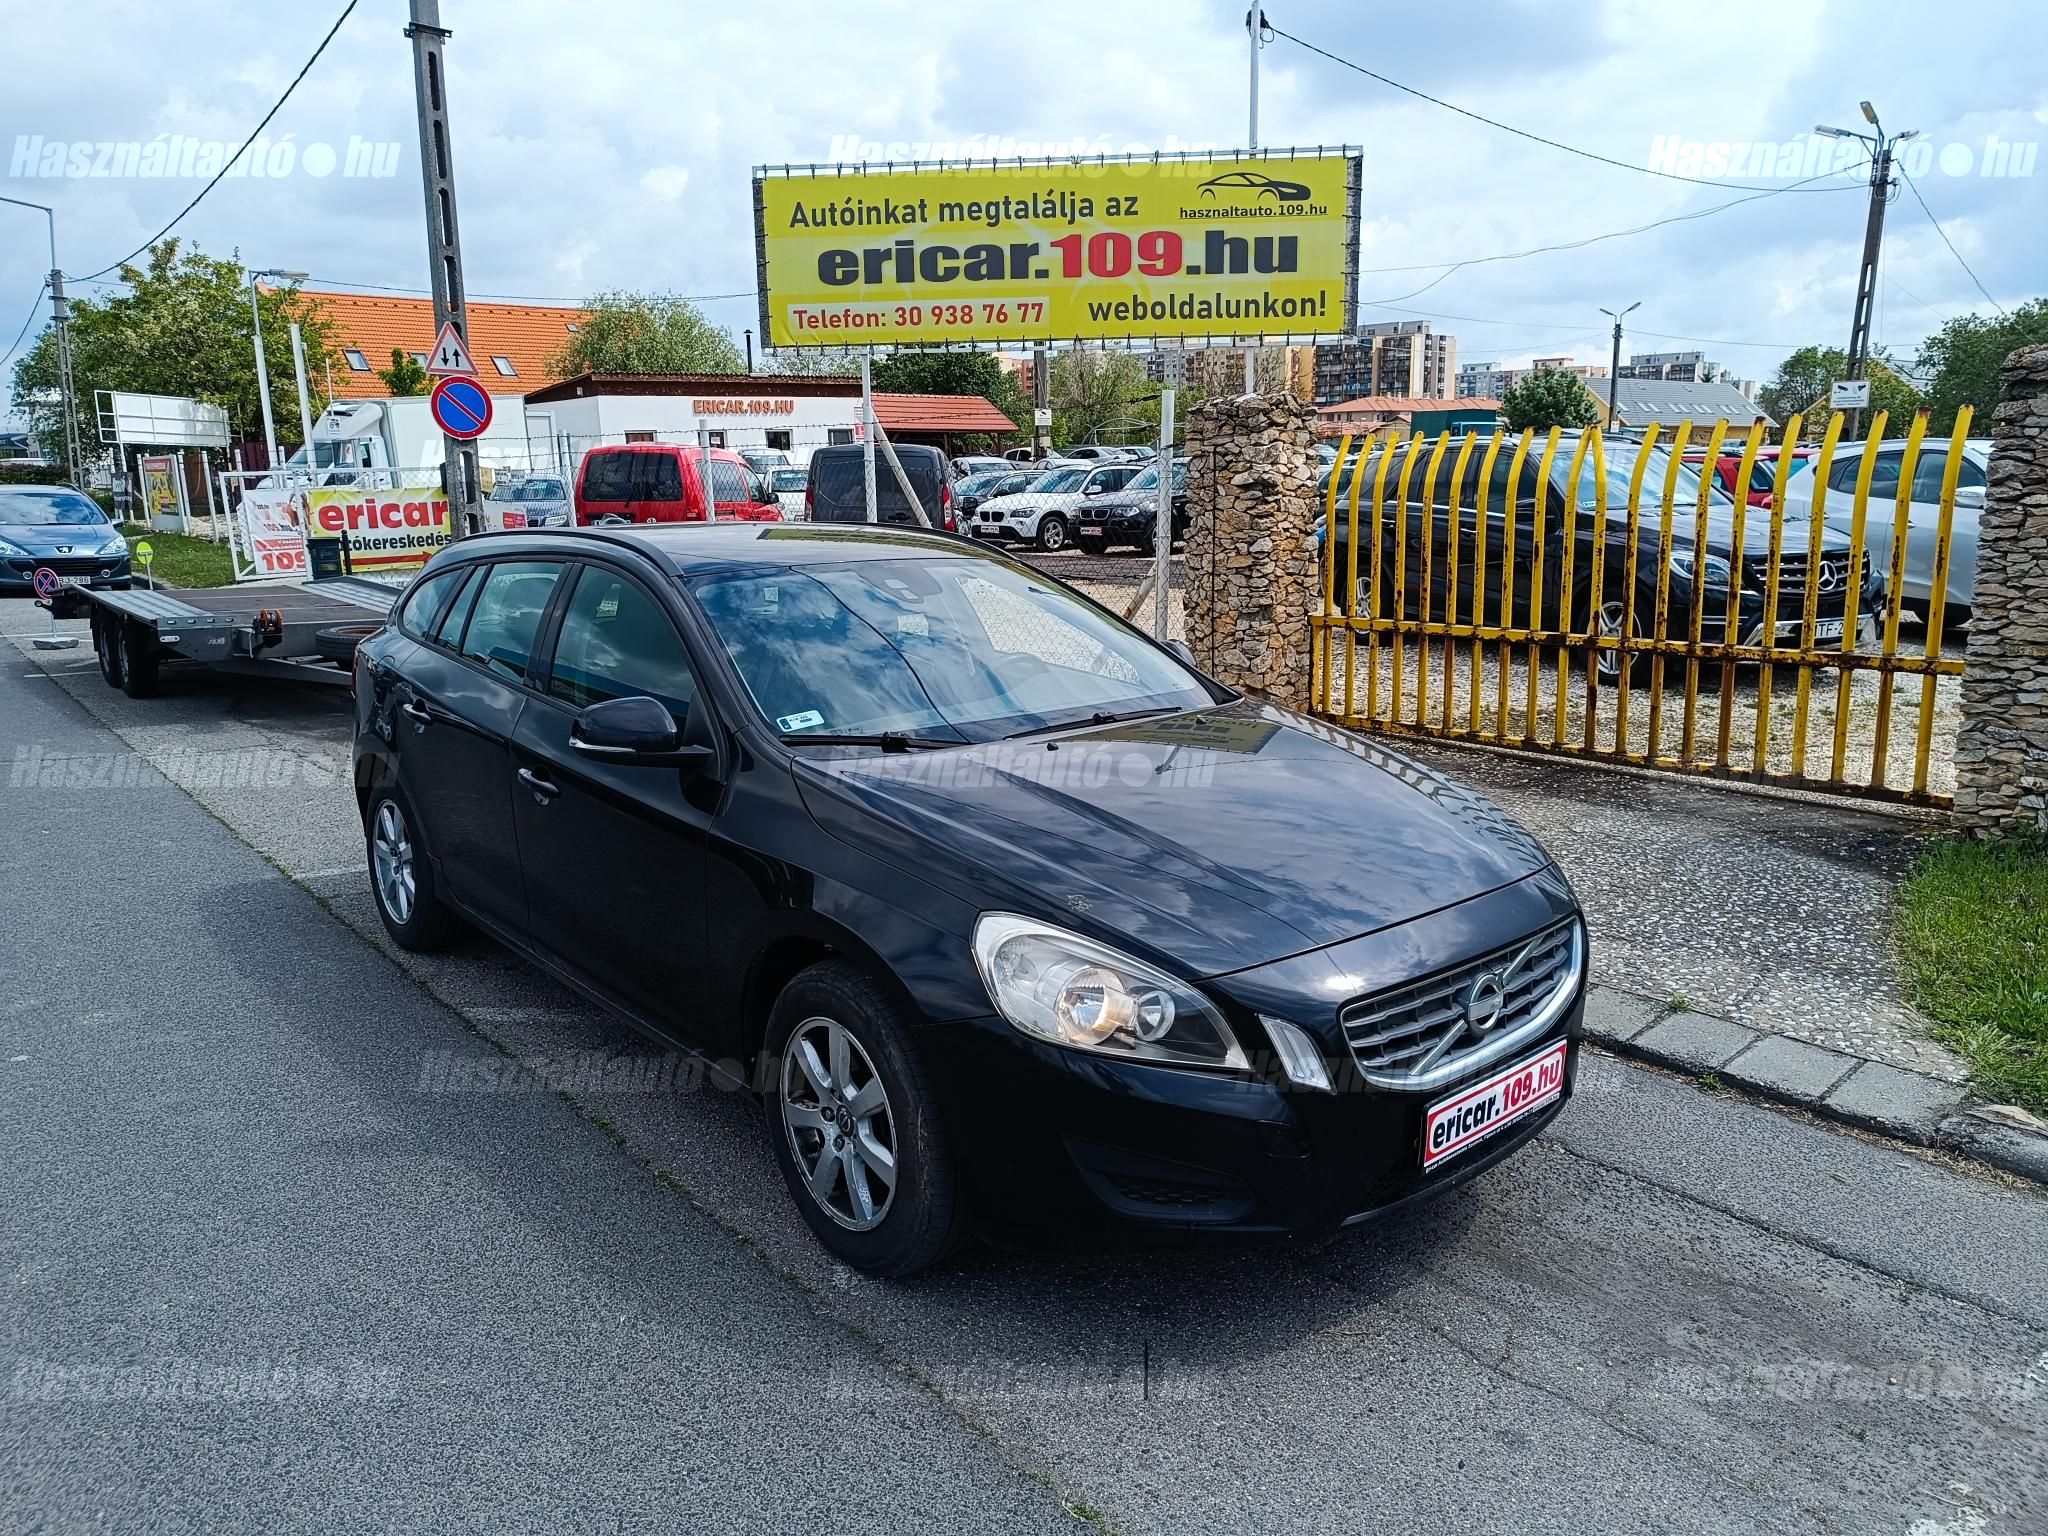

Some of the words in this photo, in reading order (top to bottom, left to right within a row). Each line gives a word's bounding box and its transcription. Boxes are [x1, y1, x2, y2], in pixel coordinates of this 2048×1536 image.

[789, 196, 928, 228] Autóinkat
[938, 188, 1094, 227] megtalálja
[1105, 195, 1139, 216] az
[1179, 203, 1328, 219] hasznaltauto.109.hu
[817, 229, 1298, 286] ericar.109.hu
[793, 308, 887, 330] Telefon:
[894, 305, 923, 326] 30
[931, 304, 974, 325] 938
[982, 303, 1009, 324] 76
[1016, 302, 1044, 323] 77
[1088, 290, 1327, 321] weboldalunkon!
[693, 399, 795, 415] ERICAR.109.HU
[317, 498, 449, 532] ericar
[1432, 1058, 1560, 1150] ericar.109.hu
